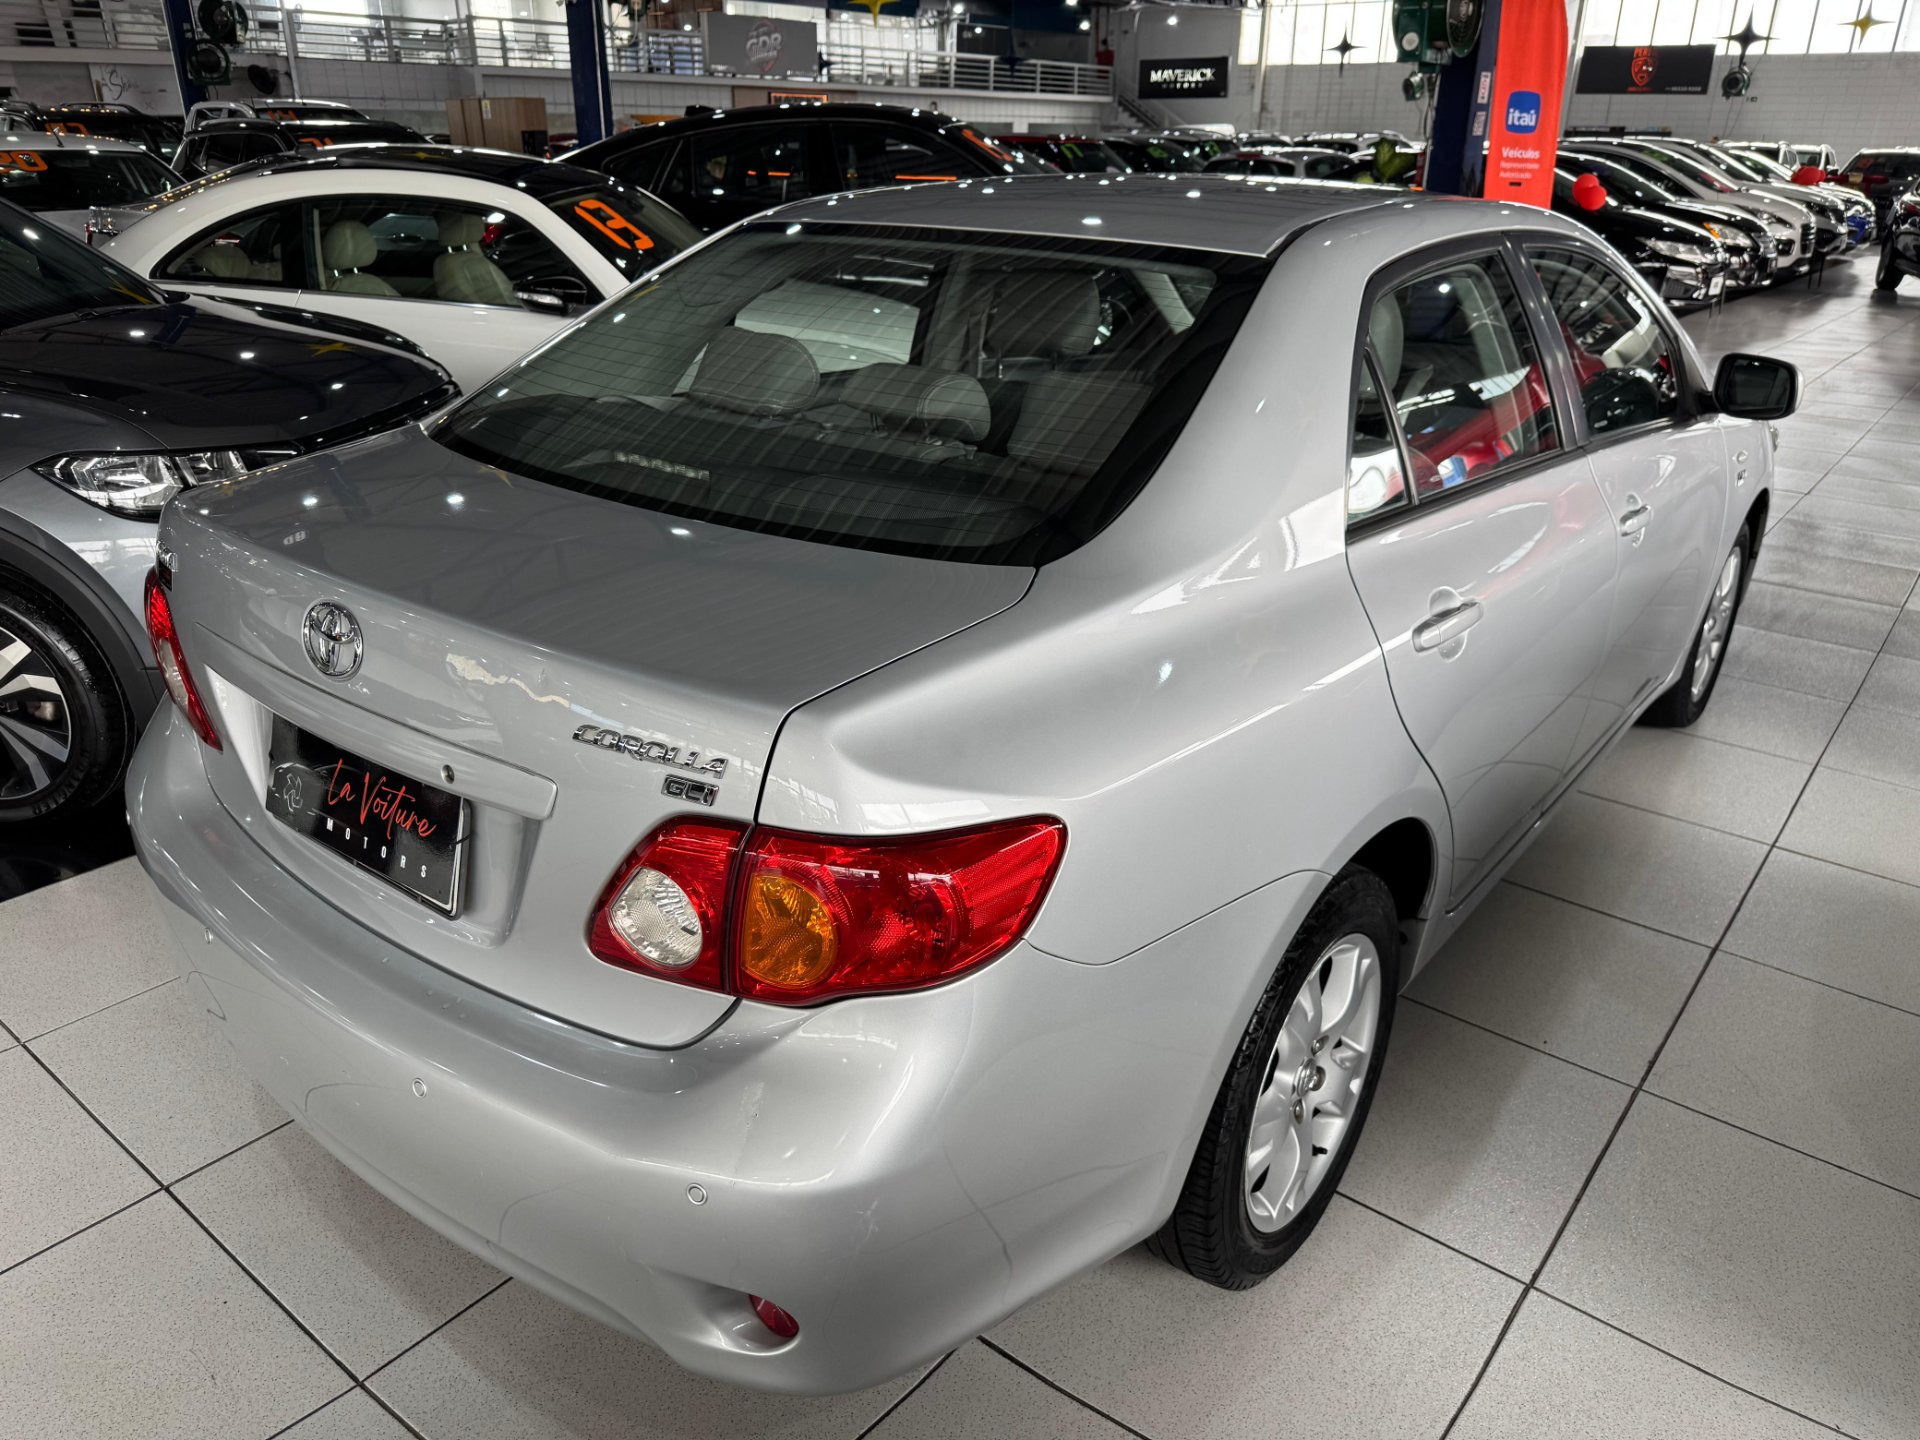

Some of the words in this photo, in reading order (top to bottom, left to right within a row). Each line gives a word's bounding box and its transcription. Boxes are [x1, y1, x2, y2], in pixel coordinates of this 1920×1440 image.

[1149, 67, 1216, 83] MAVERICK
[1507, 108, 1537, 126] itaú
[1502, 147, 1540, 159] Veículos
[572, 724, 728, 779] COROLLA
[327, 758, 356, 805] La
[360, 772, 438, 840] Voiture
[326, 817, 428, 878] MOTORS
